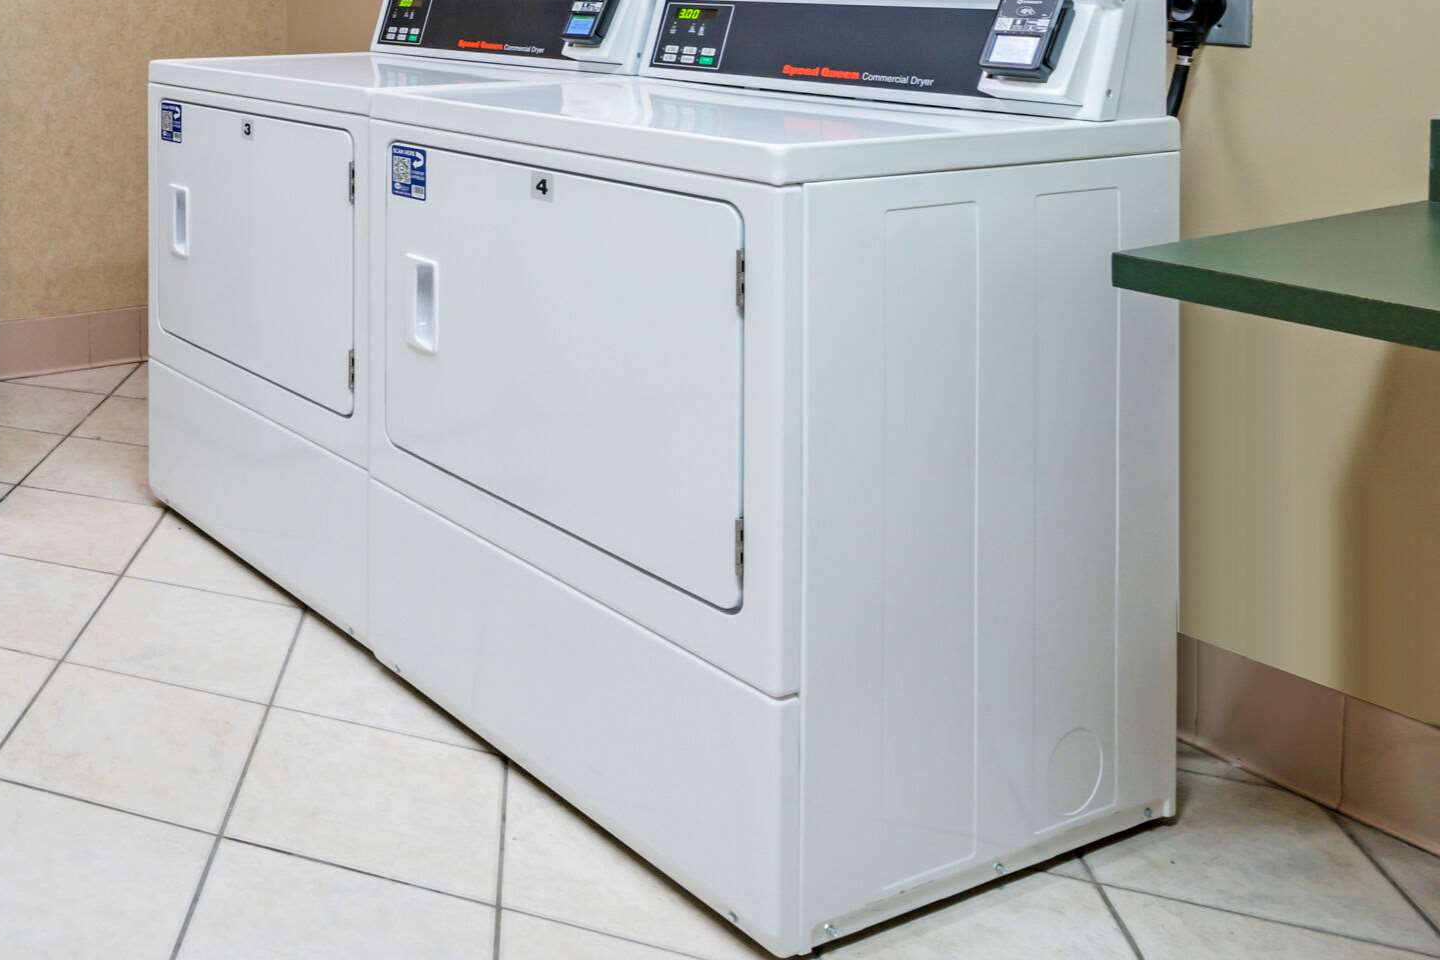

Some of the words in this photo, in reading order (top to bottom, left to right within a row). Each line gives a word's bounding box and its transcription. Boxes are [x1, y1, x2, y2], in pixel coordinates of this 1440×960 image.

[862, 71, 909, 85] Commercial
[910, 76, 935, 88] Dryer
[243, 123, 252, 136] 3
[535, 178, 548, 195] 4
